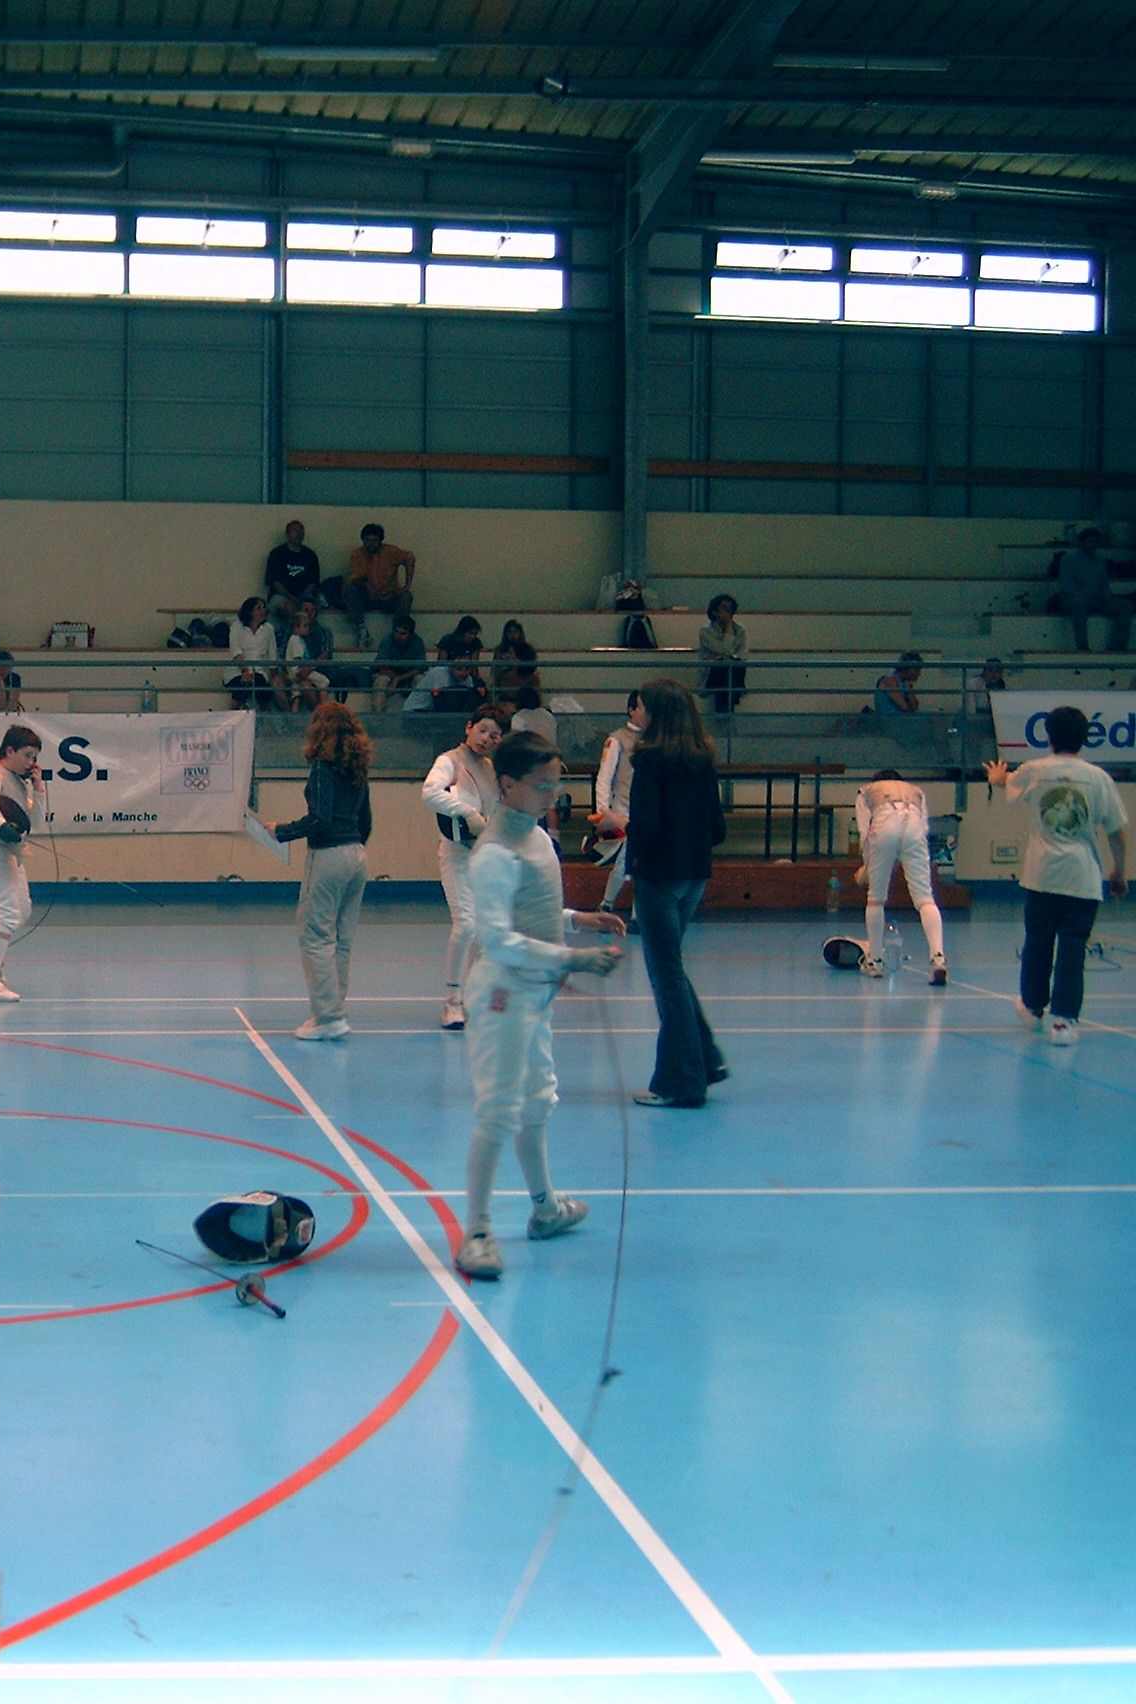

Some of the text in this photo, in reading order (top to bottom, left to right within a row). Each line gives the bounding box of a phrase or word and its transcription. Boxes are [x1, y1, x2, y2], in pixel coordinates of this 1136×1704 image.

[1025, 711, 1136, 748] Céd
[73, 812, 87, 822] de
[92, 812, 103, 822] la
[111, 811, 158, 822] Manche
